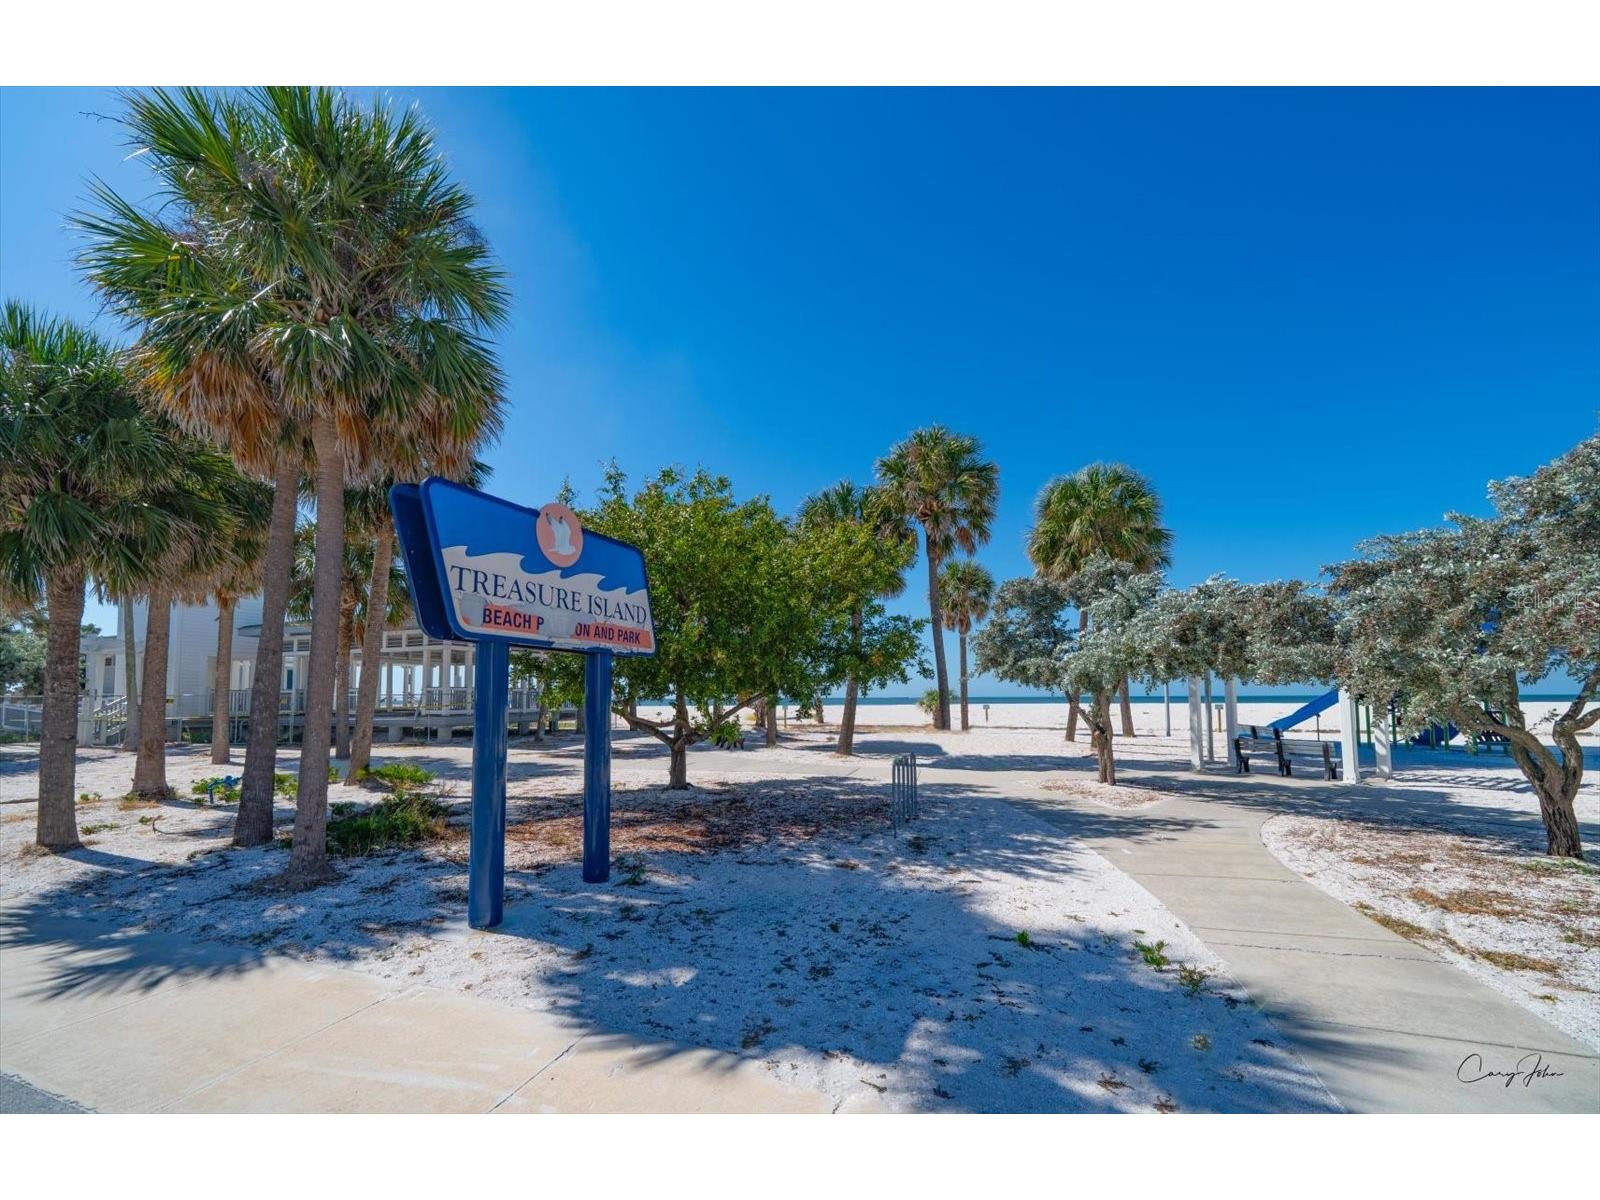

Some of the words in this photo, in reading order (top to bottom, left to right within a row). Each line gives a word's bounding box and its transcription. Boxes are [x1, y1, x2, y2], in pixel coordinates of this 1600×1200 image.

[450, 565, 581, 612] TREASURE
[588, 594, 647, 624] ISLAND
[483, 608, 531, 629] BEACH
[594, 625, 614, 641] AND
[618, 630, 640, 644] PARK
